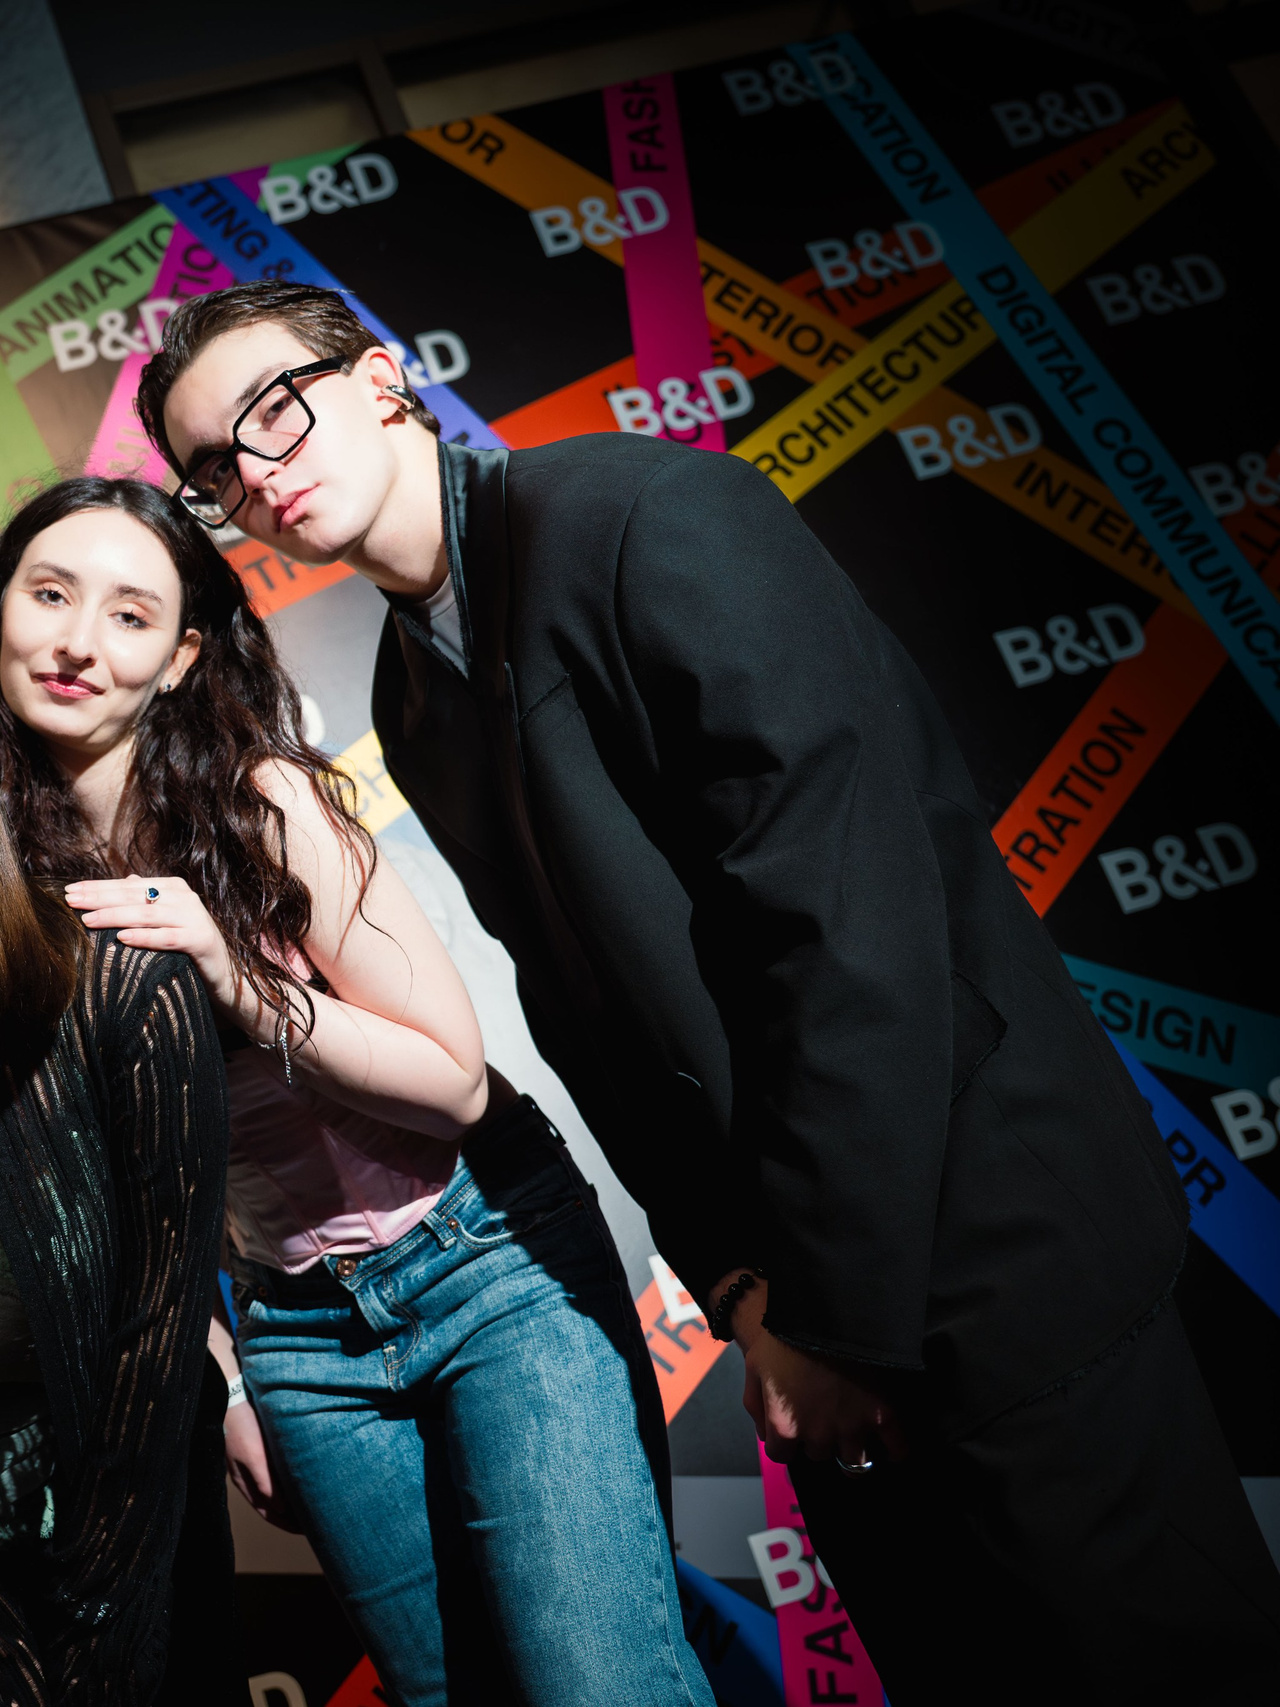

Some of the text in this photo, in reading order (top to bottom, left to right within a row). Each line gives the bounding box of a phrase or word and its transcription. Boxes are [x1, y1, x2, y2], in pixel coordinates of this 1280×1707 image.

[721, 49, 858, 118] B&D
[990, 81, 1127, 150] B&D
[622, 81, 667, 172] FAS
[1121, 122, 1199, 199] ARC
[258, 152, 399, 226] B&D
[529, 185, 670, 258] B&D
[804, 219, 946, 291] B&D
[1086, 253, 1228, 327] B&D
[977, 264, 1099, 416] DIGITAL
[607, 365, 755, 438] B&D
[896, 402, 1044, 481] B&D
[1014, 461, 1163, 575] INTER
[992, 602, 1147, 689] B&D
[1097, 821, 1259, 915] B&D
